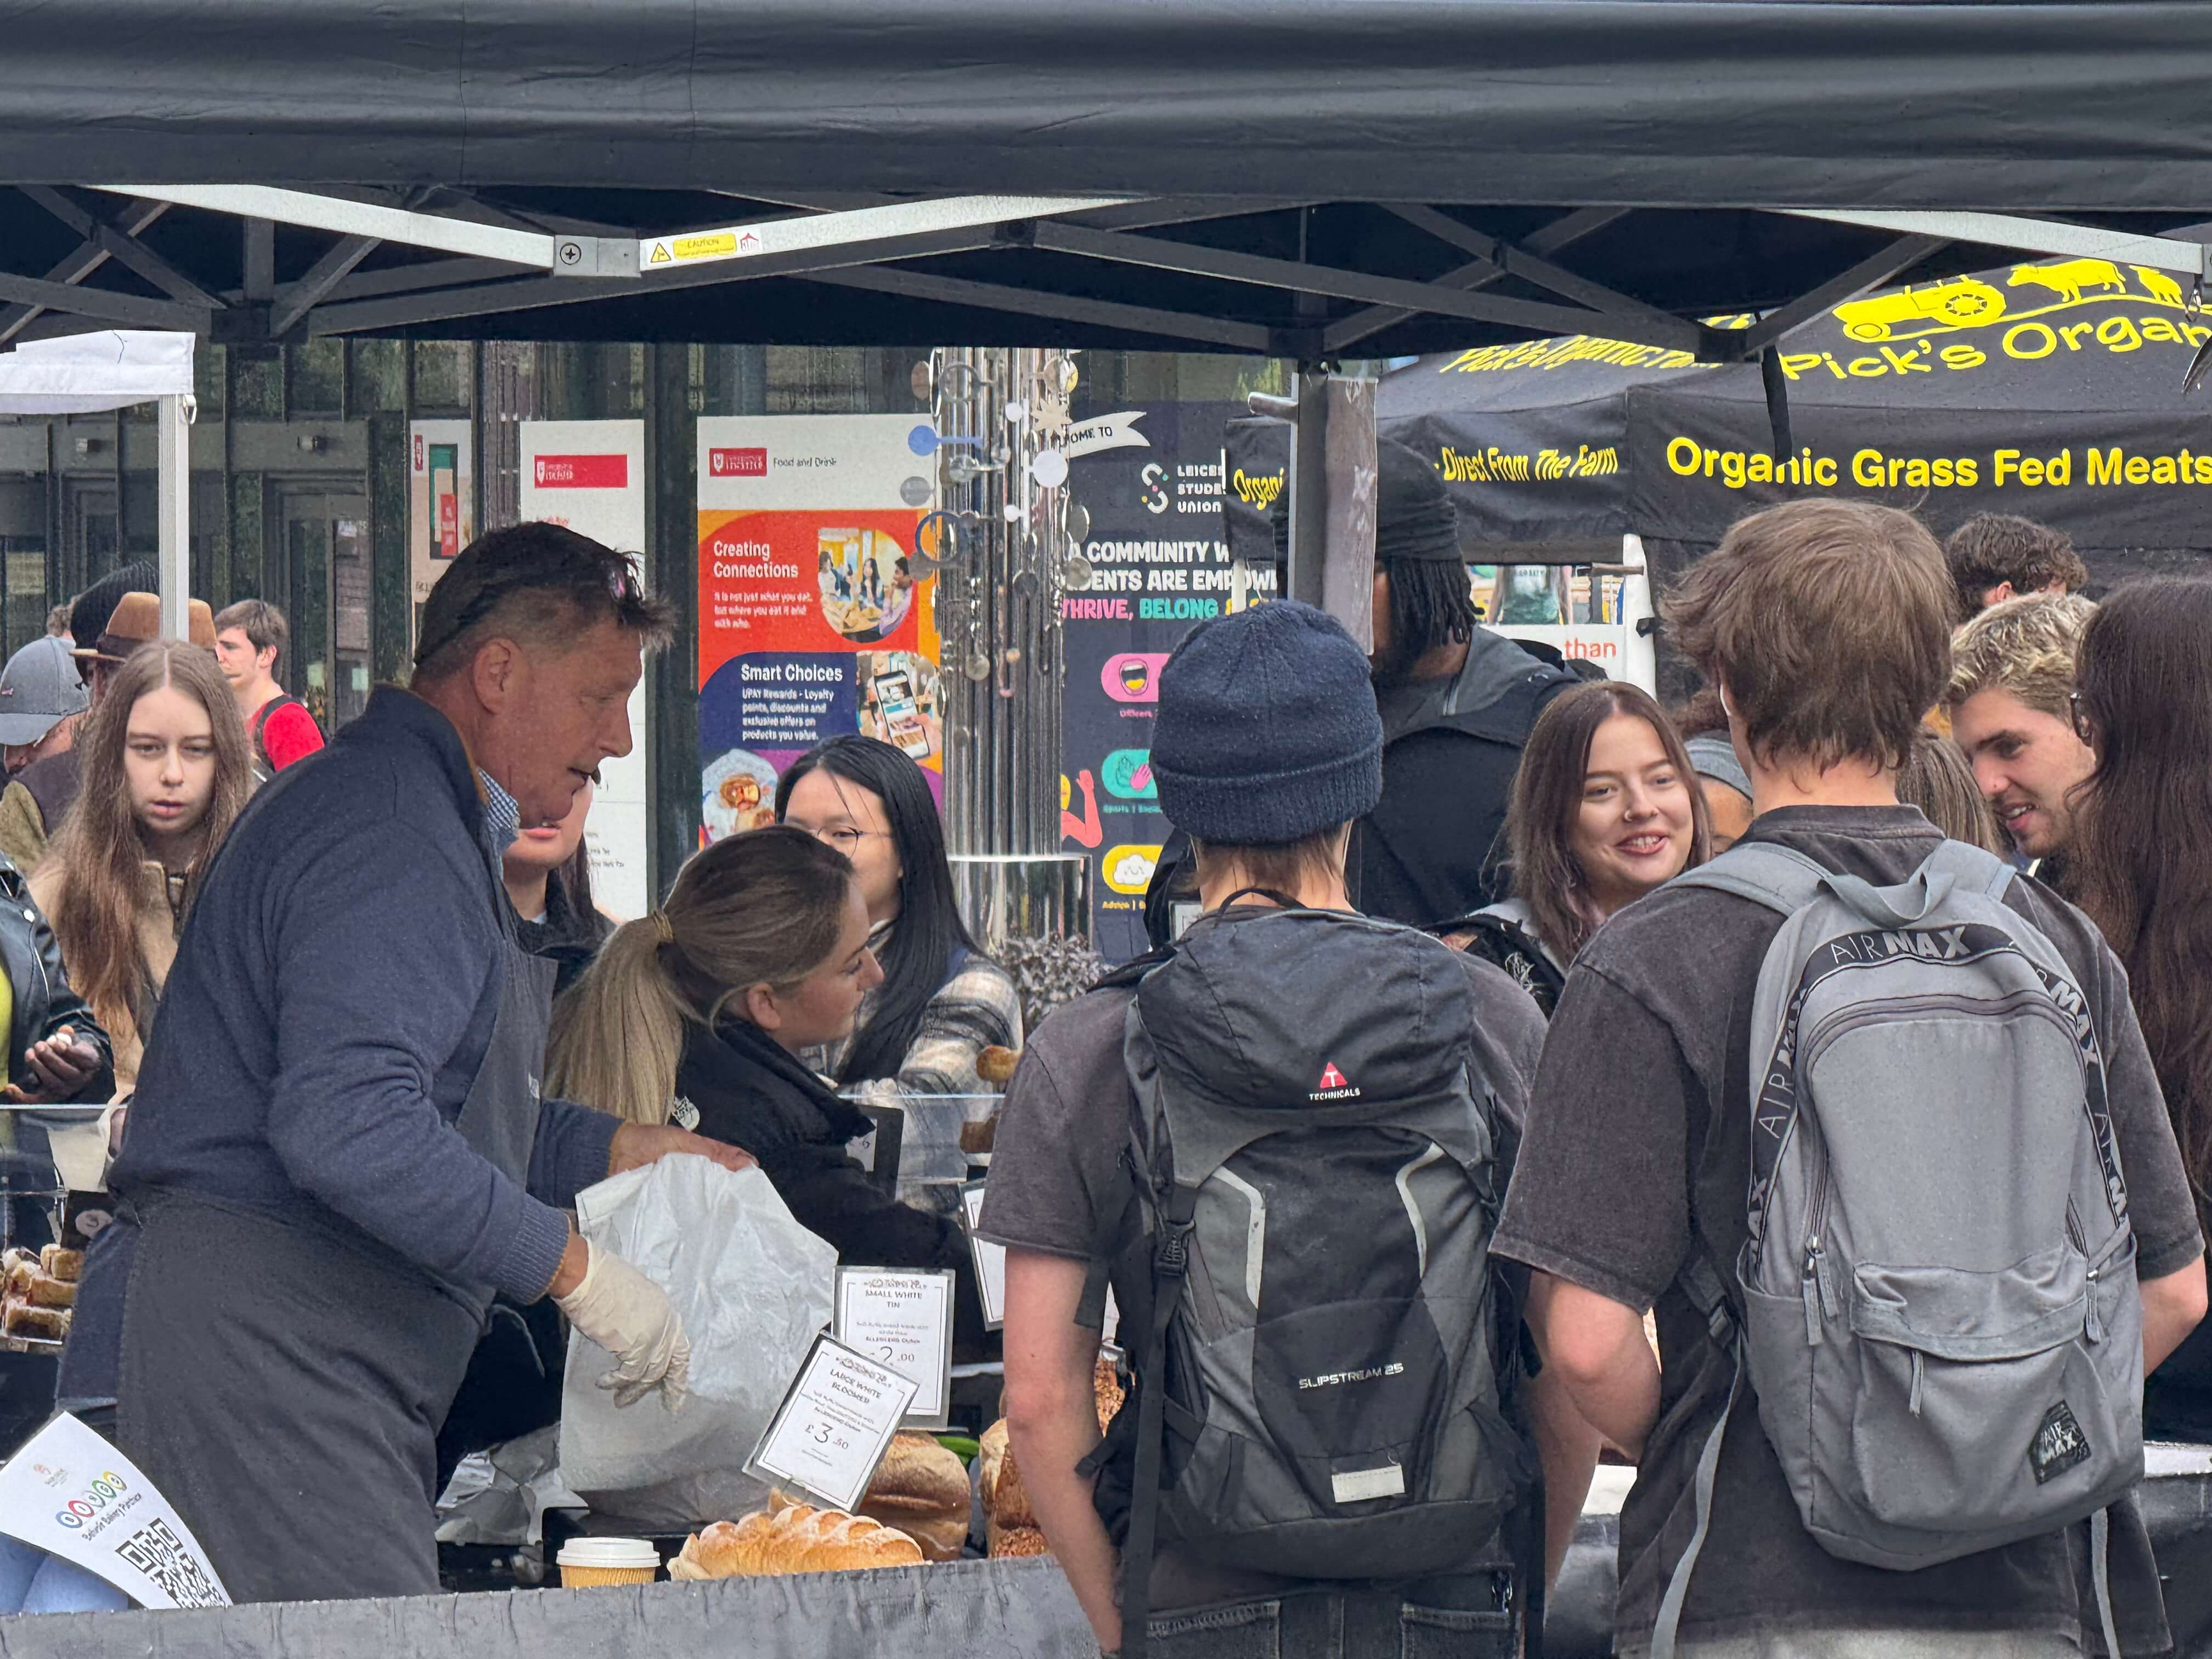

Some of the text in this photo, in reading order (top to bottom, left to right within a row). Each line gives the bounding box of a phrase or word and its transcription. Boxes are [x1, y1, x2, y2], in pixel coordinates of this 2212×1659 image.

[687, 238, 719, 248] CAUTION
[1779, 339, 1985, 380] Pick's
[1098, 426, 1113, 437] TO
[1442, 444, 1618, 481] Direct From The Farm
[1667, 437, 2212, 488] Organic Grass Fed Meats
[1177, 483, 1226, 495] STUDE
[1233, 467, 1284, 510] Organi
[714, 540, 770, 561] Creating
[1087, 540, 1210, 563] COMMUNITY
[713, 561, 799, 578] Connections
[1147, 569, 1187, 591] ARE
[1062, 597, 1134, 621] THRIVE,
[1139, 598, 1218, 619] BELONG
[1565, 636, 1616, 659] than
[741, 664, 843, 682] Smart Choices
[742, 687, 761, 699] UPAY
[763, 689, 797, 699] Rewards
[804, 689, 834, 702] Loyalty
[810, 703, 827, 713] and
[778, 731, 793, 742] you
[1310, 1087, 1361, 1101] TECHNICALS
[1299, 1363, 1404, 1389] SLIPSTREAM 25
